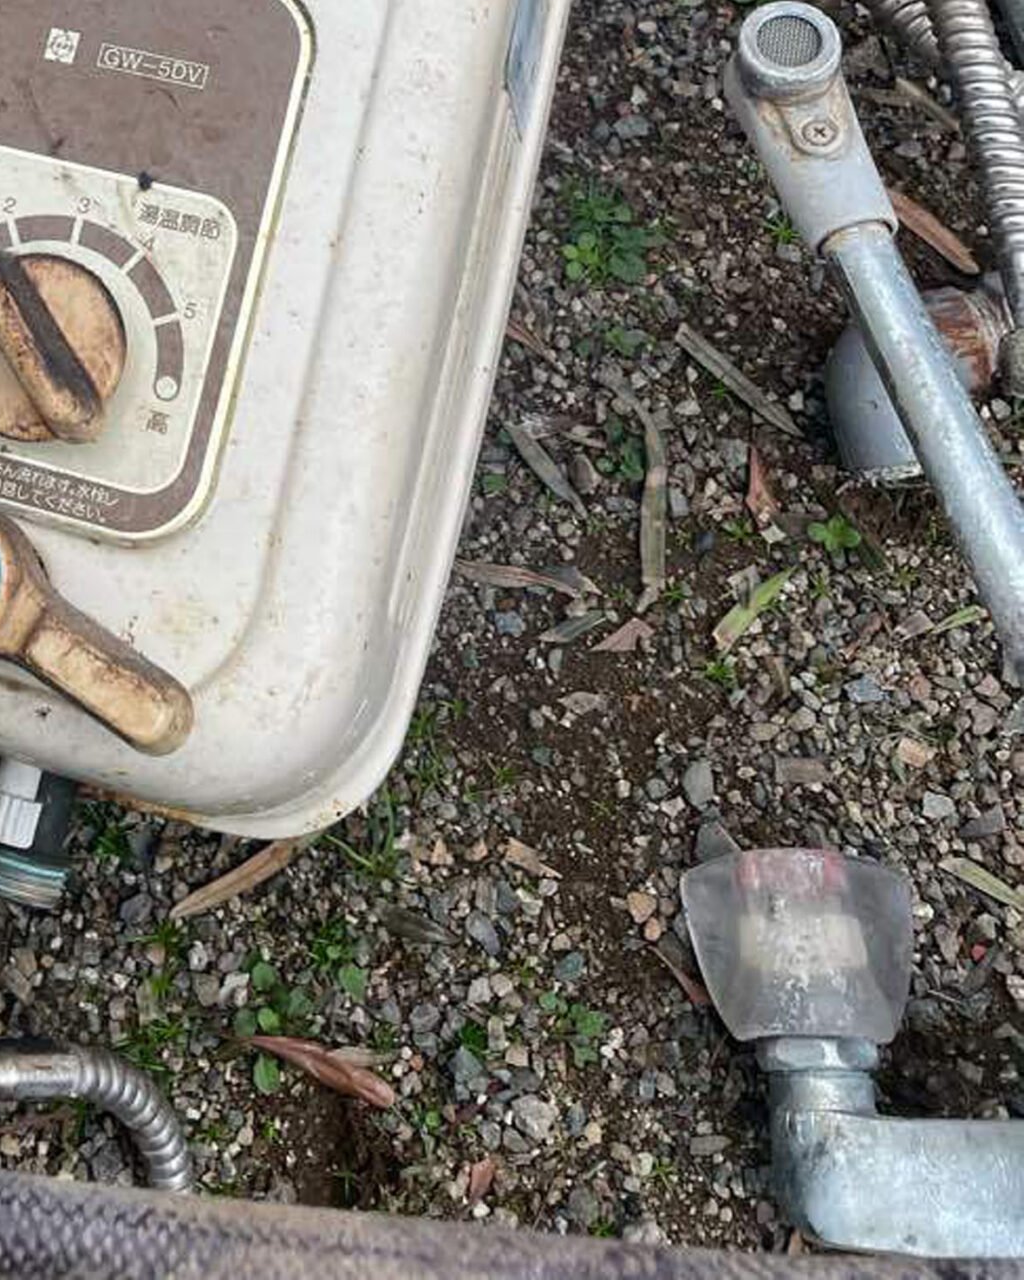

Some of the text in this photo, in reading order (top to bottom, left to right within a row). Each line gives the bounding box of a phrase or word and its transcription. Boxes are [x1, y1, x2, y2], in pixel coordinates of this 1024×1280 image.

[103, 48, 203, 83] GW-5DV
[3, 197, 17, 214] 2
[77, 197, 91, 214] 3
[138, 204, 222, 239] 湯温調節
[183, 303, 196, 319] 5
[145, 410, 172, 436] 高
